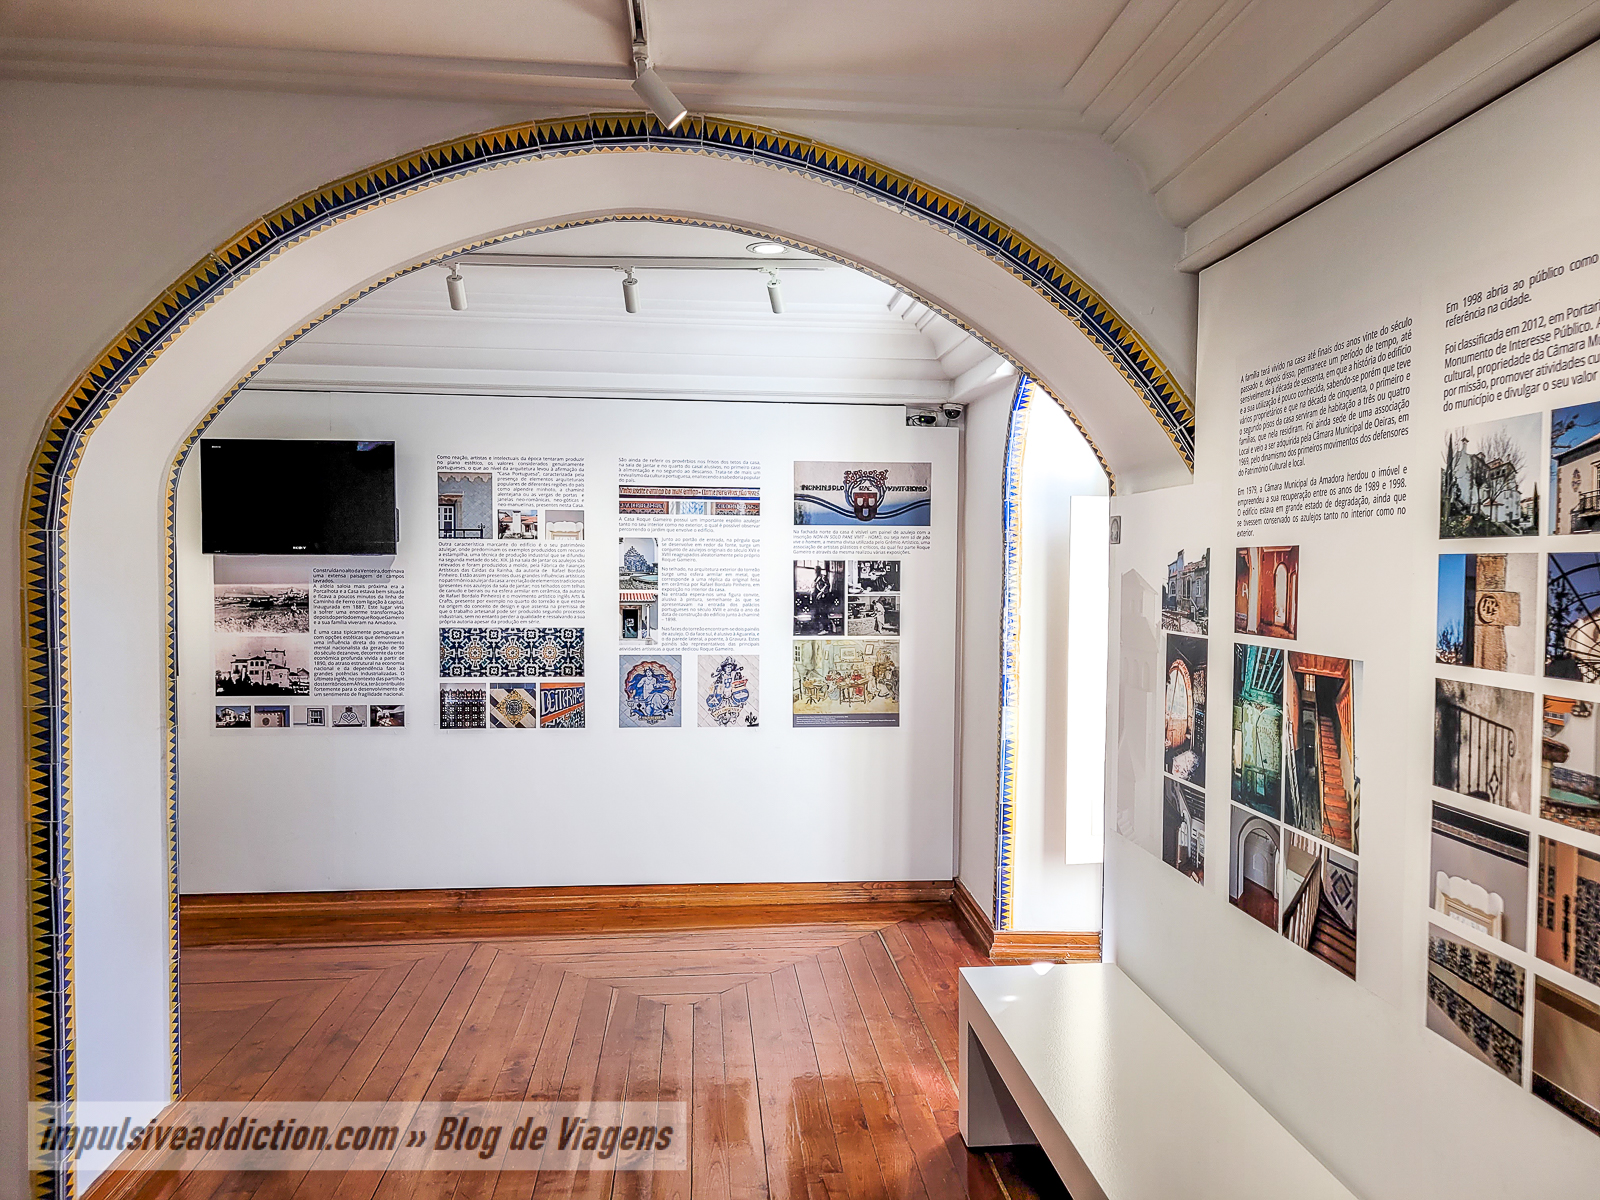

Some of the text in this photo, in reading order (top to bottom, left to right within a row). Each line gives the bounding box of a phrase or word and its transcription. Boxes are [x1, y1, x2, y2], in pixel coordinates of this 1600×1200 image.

[1446, 254, 1599, 314] Em 1998 abria ao público como
[1445, 292, 1532, 328] referência na cidade.
[1245, 370, 1260, 382] família
[1260, 365, 1270, 377] terá
[1271, 361, 1286, 373] vivido
[1294, 355, 1306, 365] casa
[1307, 349, 1316, 361] até
[1317, 345, 1333, 358] finais
[1333, 341, 1345, 352] dos
[1346, 336, 1361, 348] anos
[1362, 330, 1378, 342] vinte
[1390, 317, 1413, 333] século
[1444, 348, 1494, 369] Monumento
[1495, 343, 1507, 355] de
[1509, 332, 1551, 352] Interesse
[1554, 322, 1594, 340] Público.
[1445, 341, 1457, 355] Foi
[1457, 328, 1504, 351] classificada
[1505, 325, 1520, 337] em
[1521, 316, 1547, 333] 2012,
[1548, 312, 1564, 325] em
[1443, 386, 1458, 401] por
[1458, 378, 1489, 394] missão,
[1490, 368, 1535, 390] promover
[1535, 356, 1586, 377] atividades
[1444, 365, 1475, 384] cultural,
[1476, 352, 1531, 378] propriedade
[1532, 348, 1545, 362] da
[1546, 340, 1585, 358] Câmara
[1243, 420, 1262, 435] segundo
[1262, 420, 1275, 432] pisos
[1283, 415, 1295, 424] casa
[1295, 409, 1318, 421] serviram
[1327, 399, 1356, 414] habitação
[1363, 393, 1376, 405] três
[1387, 386, 1410, 401] quatro
[1443, 370, 1598, 412] do município e divulgar o seu valor
[1239, 434, 1256, 446] famílias,
[1257, 433, 1267, 442] que
[1267, 429, 1278, 439] nela
[1279, 424, 1304, 436] residiram.
[1305, 420, 1314, 430] Foi
[1315, 416, 1331, 428] ainda
[1332, 413, 1347, 425] sede
[1358, 408, 1373, 419] uma
[1374, 398, 1410, 415] associação
[1237, 495, 1265, 508] empreendeu
[1280, 489, 1312, 503] recuperação
[1312, 489, 1328, 498] entre
[1337, 486, 1353, 495] anos
[1365, 480, 1380, 492] 1989
[1389, 477, 1407, 489] 1998.
[1246, 485, 1257, 495] 1979,
[1264, 483, 1282, 492] Câmara
[1284, 478, 1308, 490] Municipal
[1318, 474, 1345, 485] Amadora
[1346, 470, 1369, 481] herdou
[1378, 465, 1400, 477] imóvel
[1242, 507, 1258, 516] edifício
[1259, 506, 1274, 514] estava
[1285, 502, 1303, 515] grande
[1304, 499, 1323, 510] estado
[1334, 495, 1370, 510] degradação,
[1372, 493, 1391, 504] ainda
[1393, 493, 1407, 504] que
